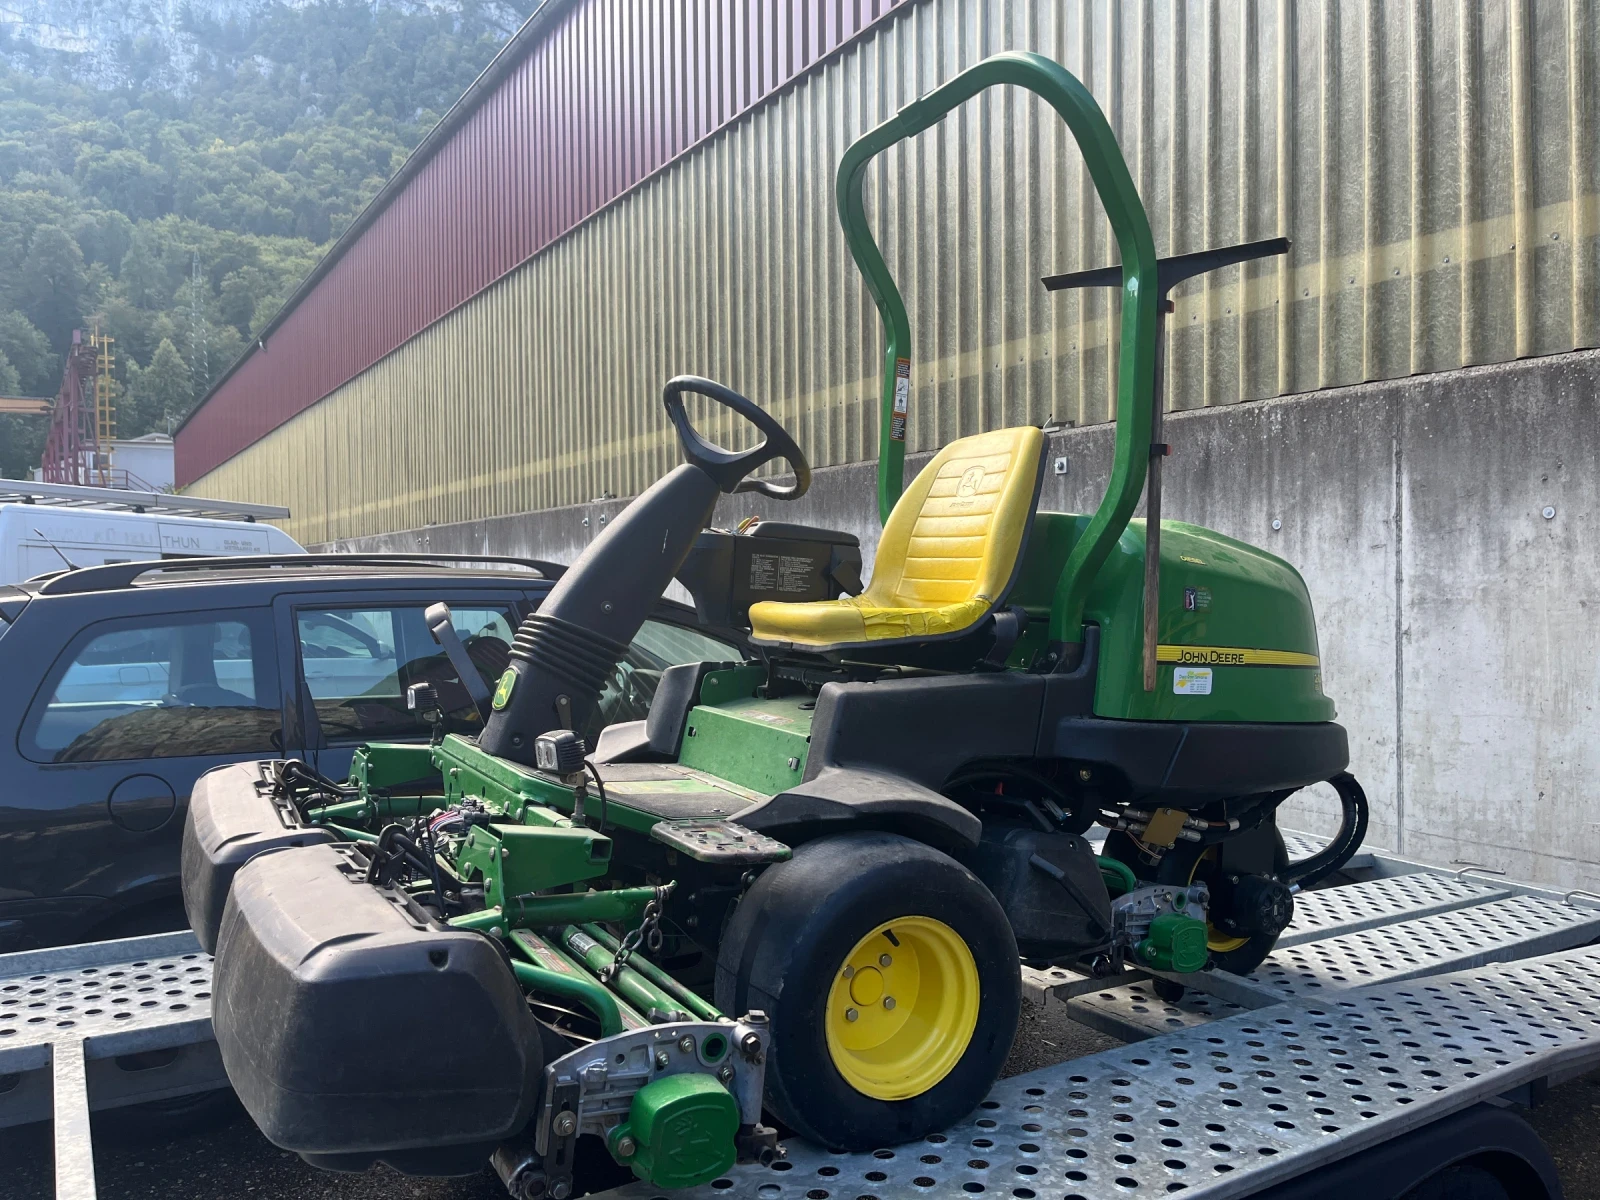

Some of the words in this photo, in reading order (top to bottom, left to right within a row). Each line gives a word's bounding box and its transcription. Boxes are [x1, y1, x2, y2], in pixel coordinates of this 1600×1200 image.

[162, 535, 200, 548] THUN
[1177, 649, 1208, 662] JOHN
[1210, 650, 1245, 663] DEERE
